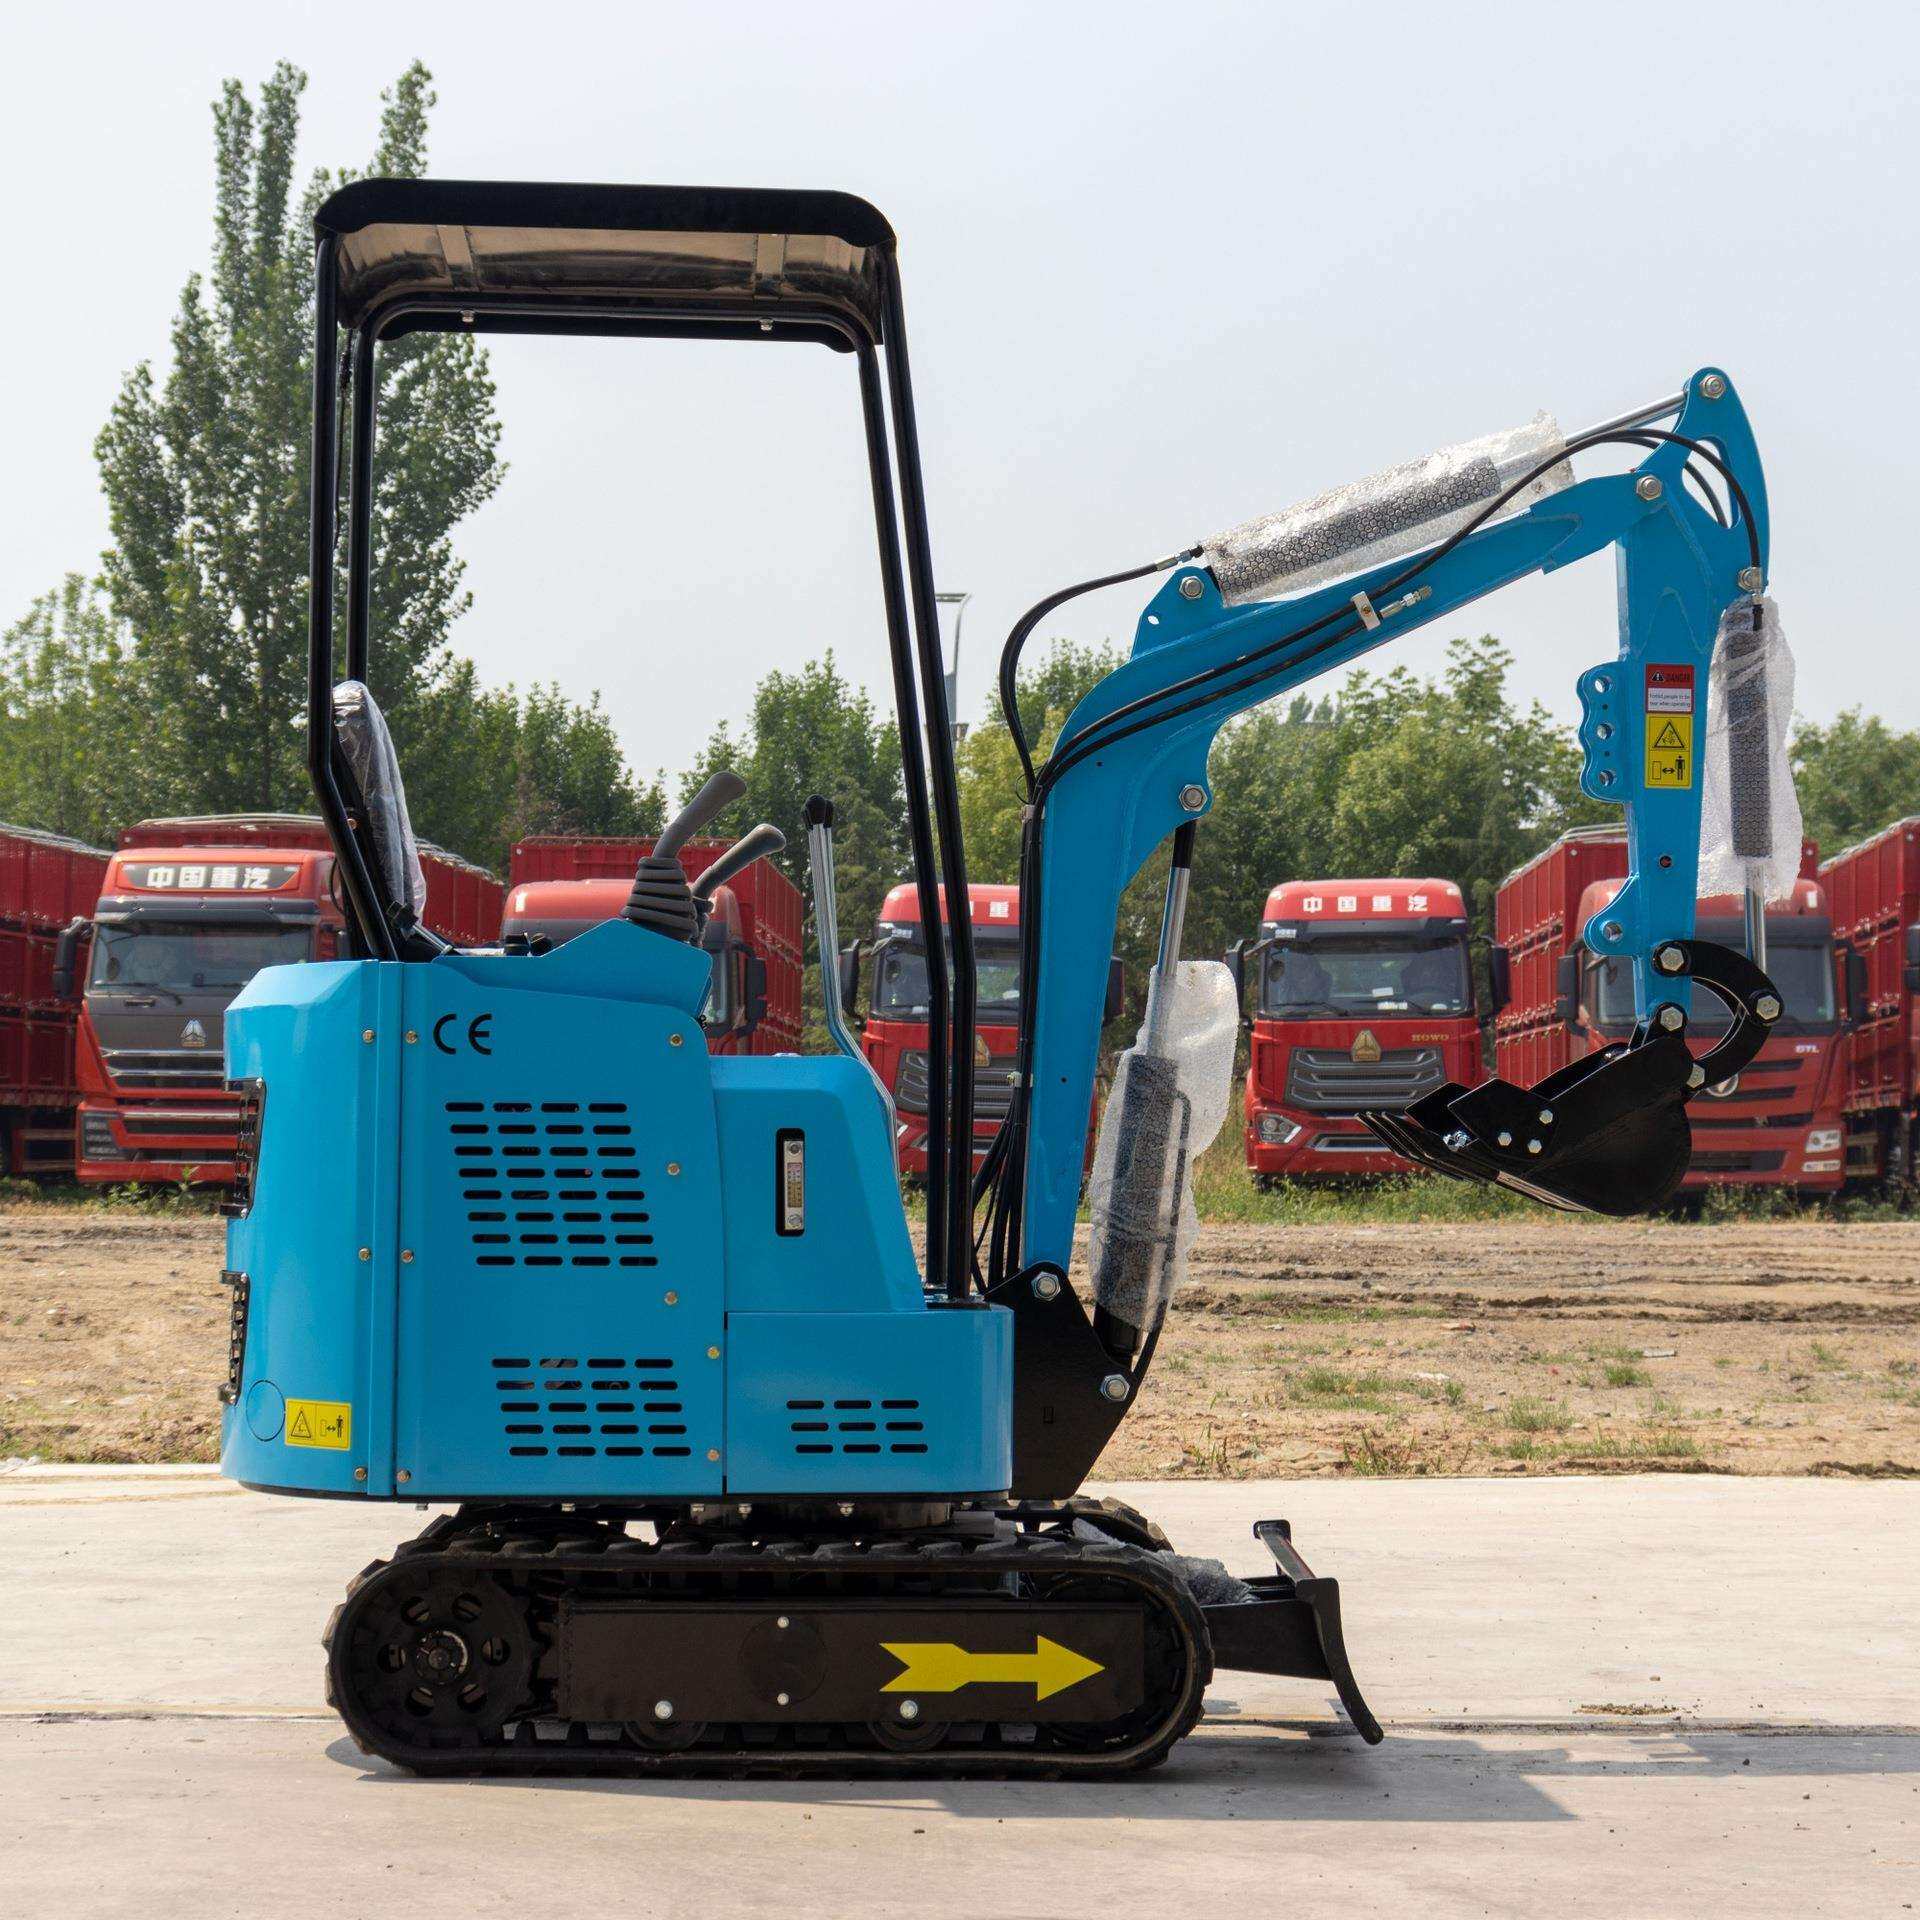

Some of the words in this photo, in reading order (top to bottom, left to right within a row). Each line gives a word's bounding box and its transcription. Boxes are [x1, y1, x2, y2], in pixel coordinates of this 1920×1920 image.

[146, 866, 270, 889] 中国重汽
[1302, 895, 1428, 913] 中国重汽
[433, 1013, 492, 1055] CE
